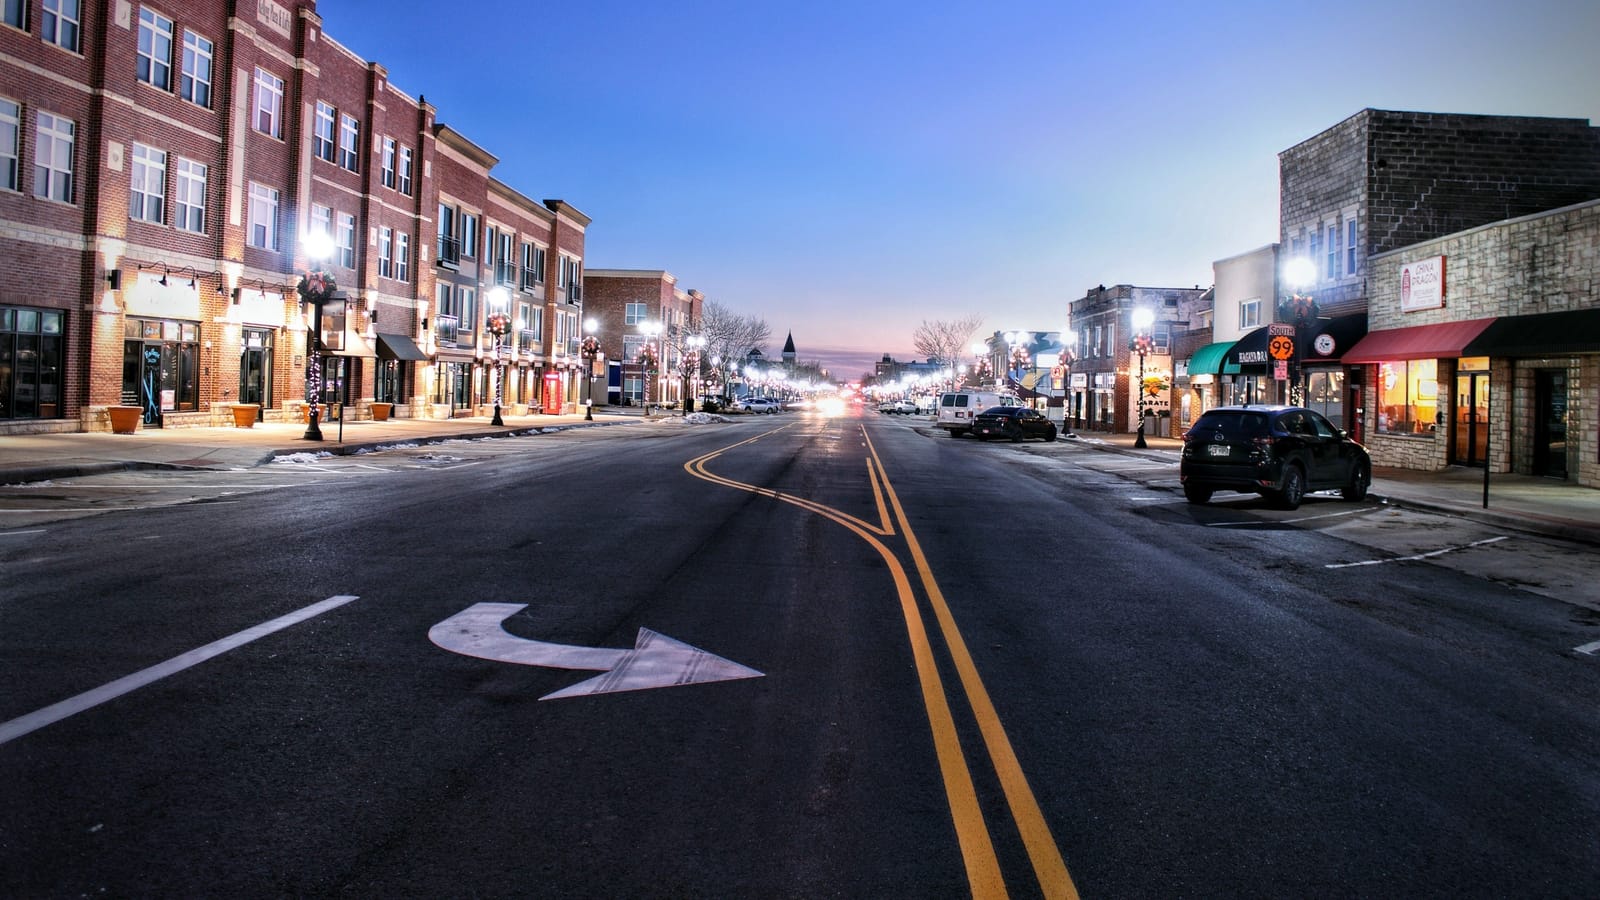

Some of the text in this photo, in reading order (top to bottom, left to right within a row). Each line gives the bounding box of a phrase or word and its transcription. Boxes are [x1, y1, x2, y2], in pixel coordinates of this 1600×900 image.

[1415, 262, 1434, 276] CHINA
[1412, 271, 1439, 286] DRAGON
[1270, 326, 1295, 336] SOUTH
[1272, 341, 1292, 354] 99
